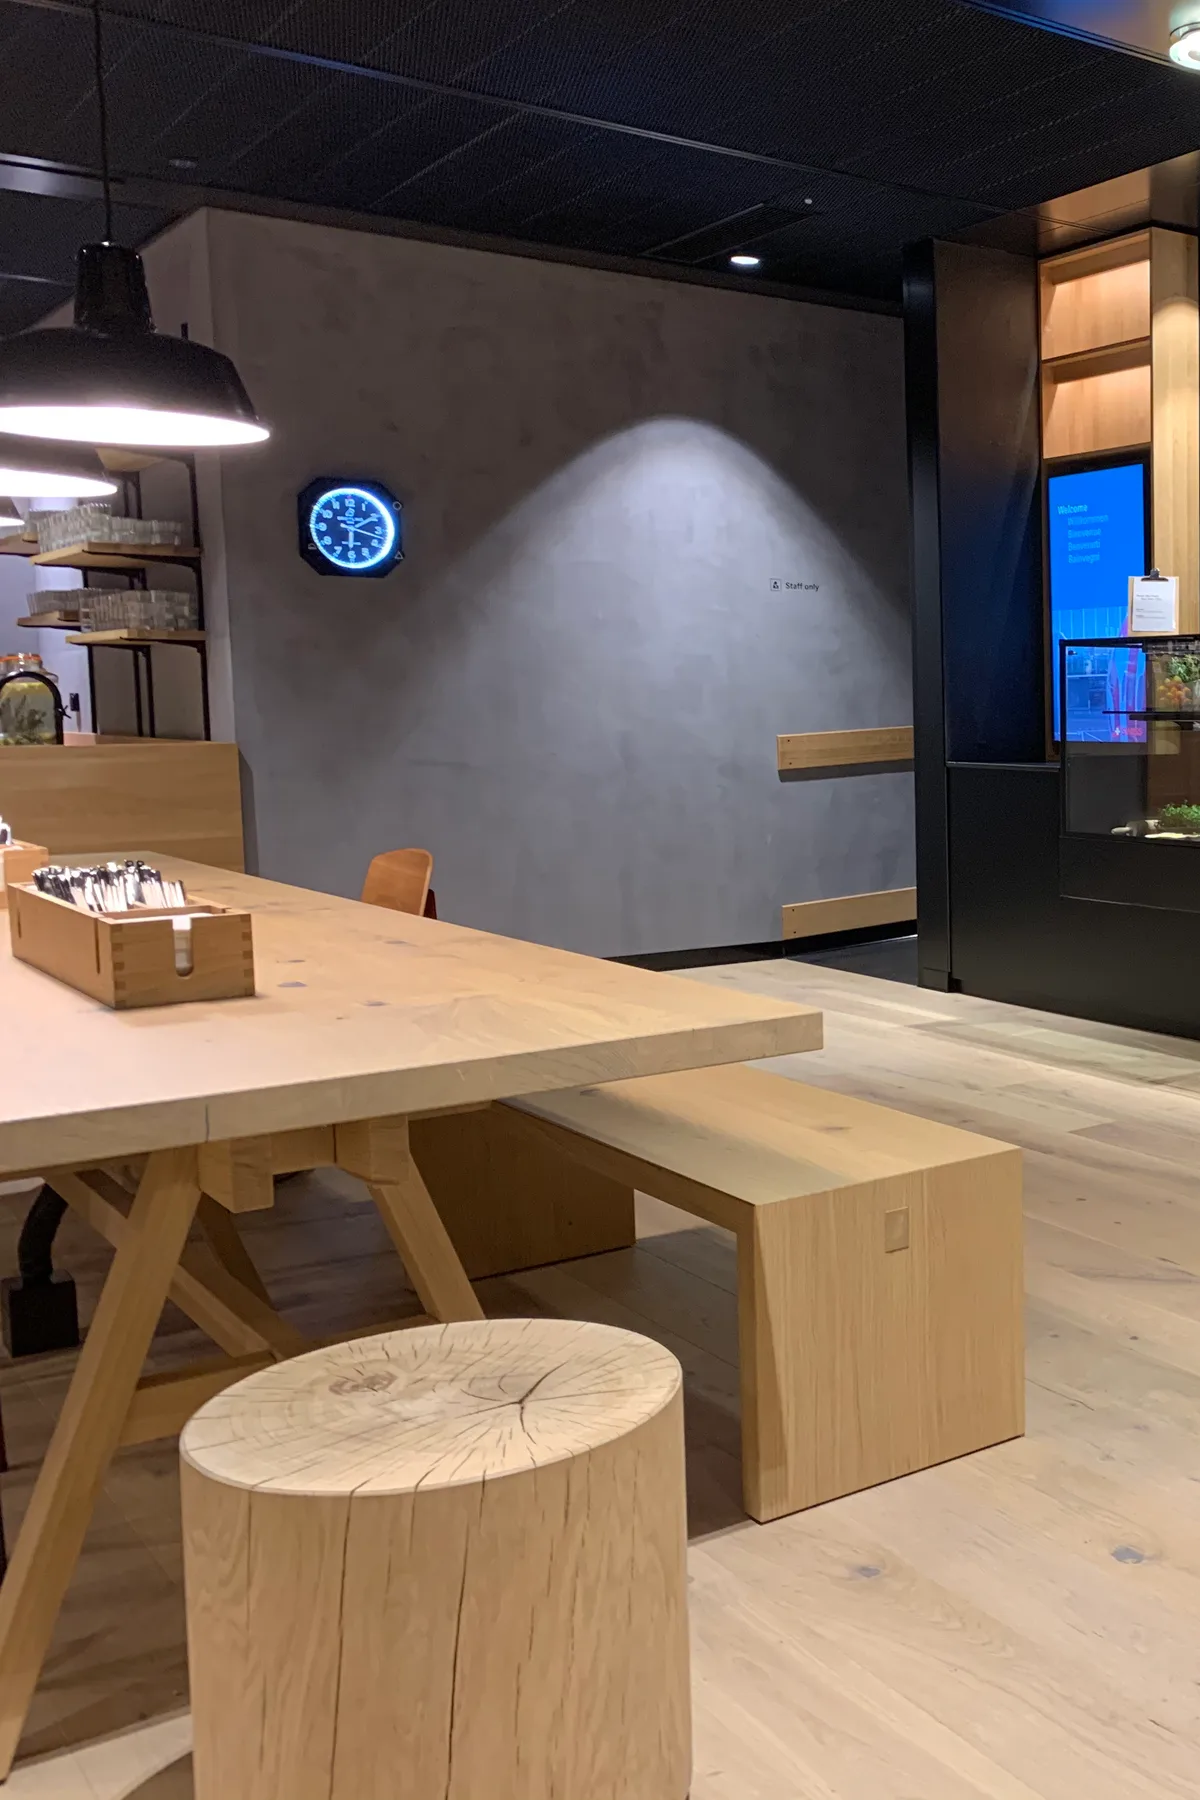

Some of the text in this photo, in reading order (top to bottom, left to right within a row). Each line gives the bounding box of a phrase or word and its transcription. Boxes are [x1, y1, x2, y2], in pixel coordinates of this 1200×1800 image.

[1057, 504, 1088, 515] Welcome
[785, 581, 820, 592] Staff only
